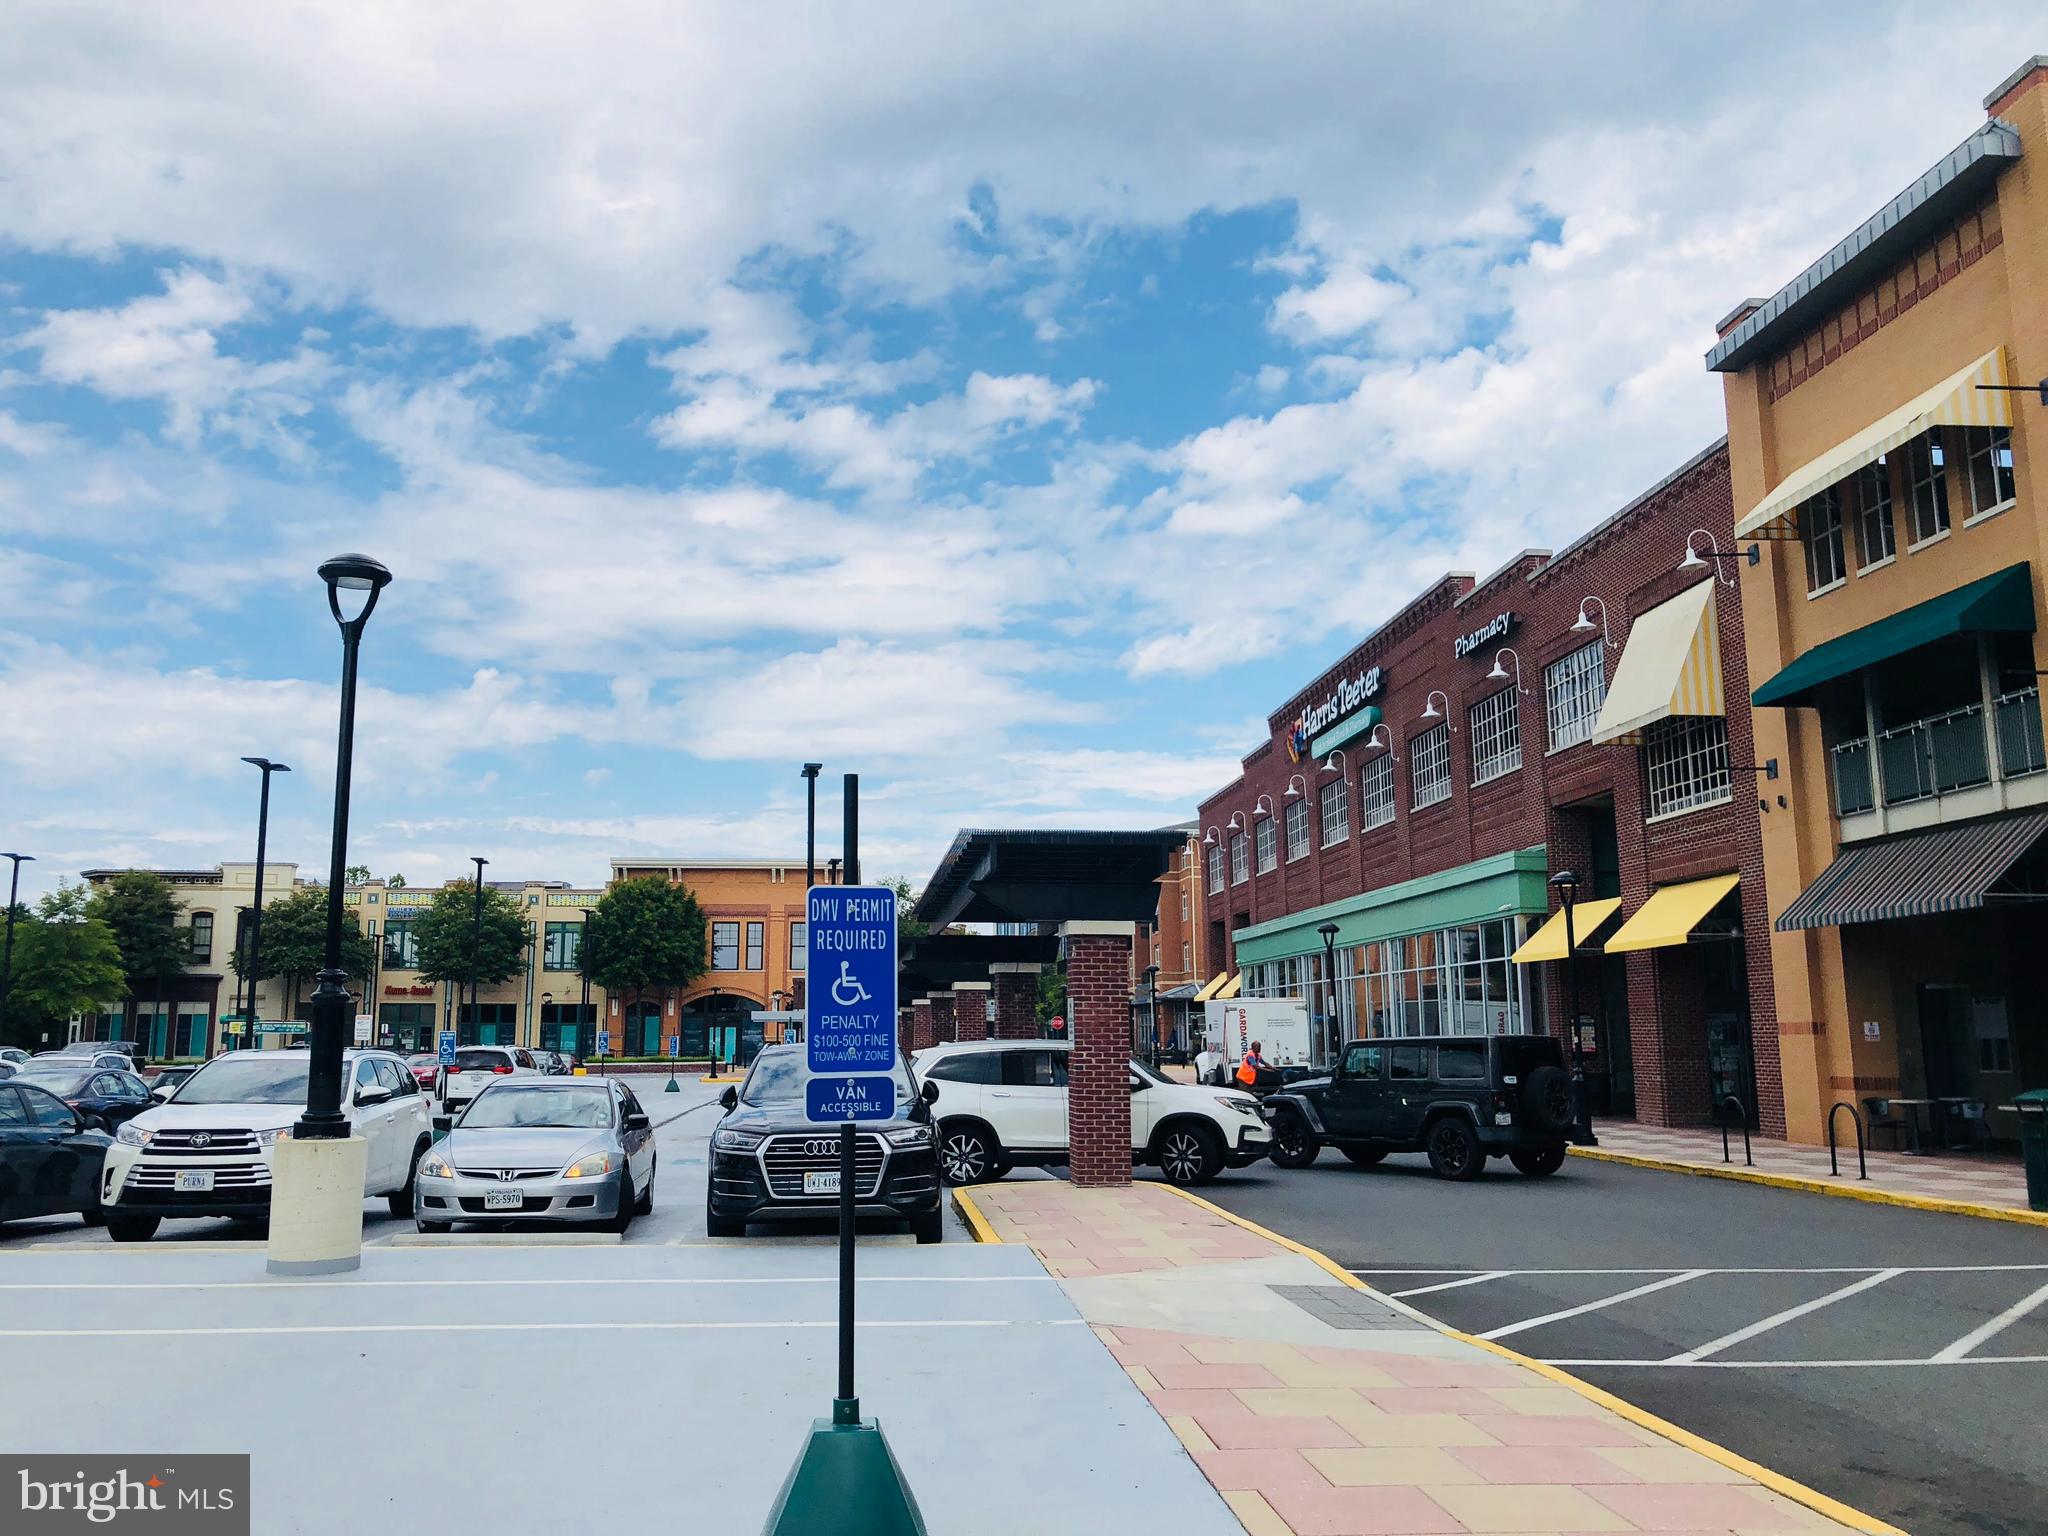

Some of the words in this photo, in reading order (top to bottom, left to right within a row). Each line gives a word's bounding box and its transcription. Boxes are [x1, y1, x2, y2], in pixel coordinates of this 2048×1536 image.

[1454, 611, 1511, 659] Pharmacy
[1301, 693, 1338, 740] Harris
[1337, 666, 1380, 715] Teeter
[811, 898, 839, 922] DMV
[846, 898, 892, 922] PERMIT
[817, 929, 887, 952] REQUIRED
[821, 1014, 880, 1030] PENALTY
[813, 1034, 861, 1048] $100-500
[864, 1033, 889, 1046] FINE
[813, 1050, 863, 1062] TOW-AWAY
[864, 1050, 890, 1061] ZONE
[835, 1086, 866, 1100] VAN
[820, 1101, 882, 1113] ACCESSIBLE
